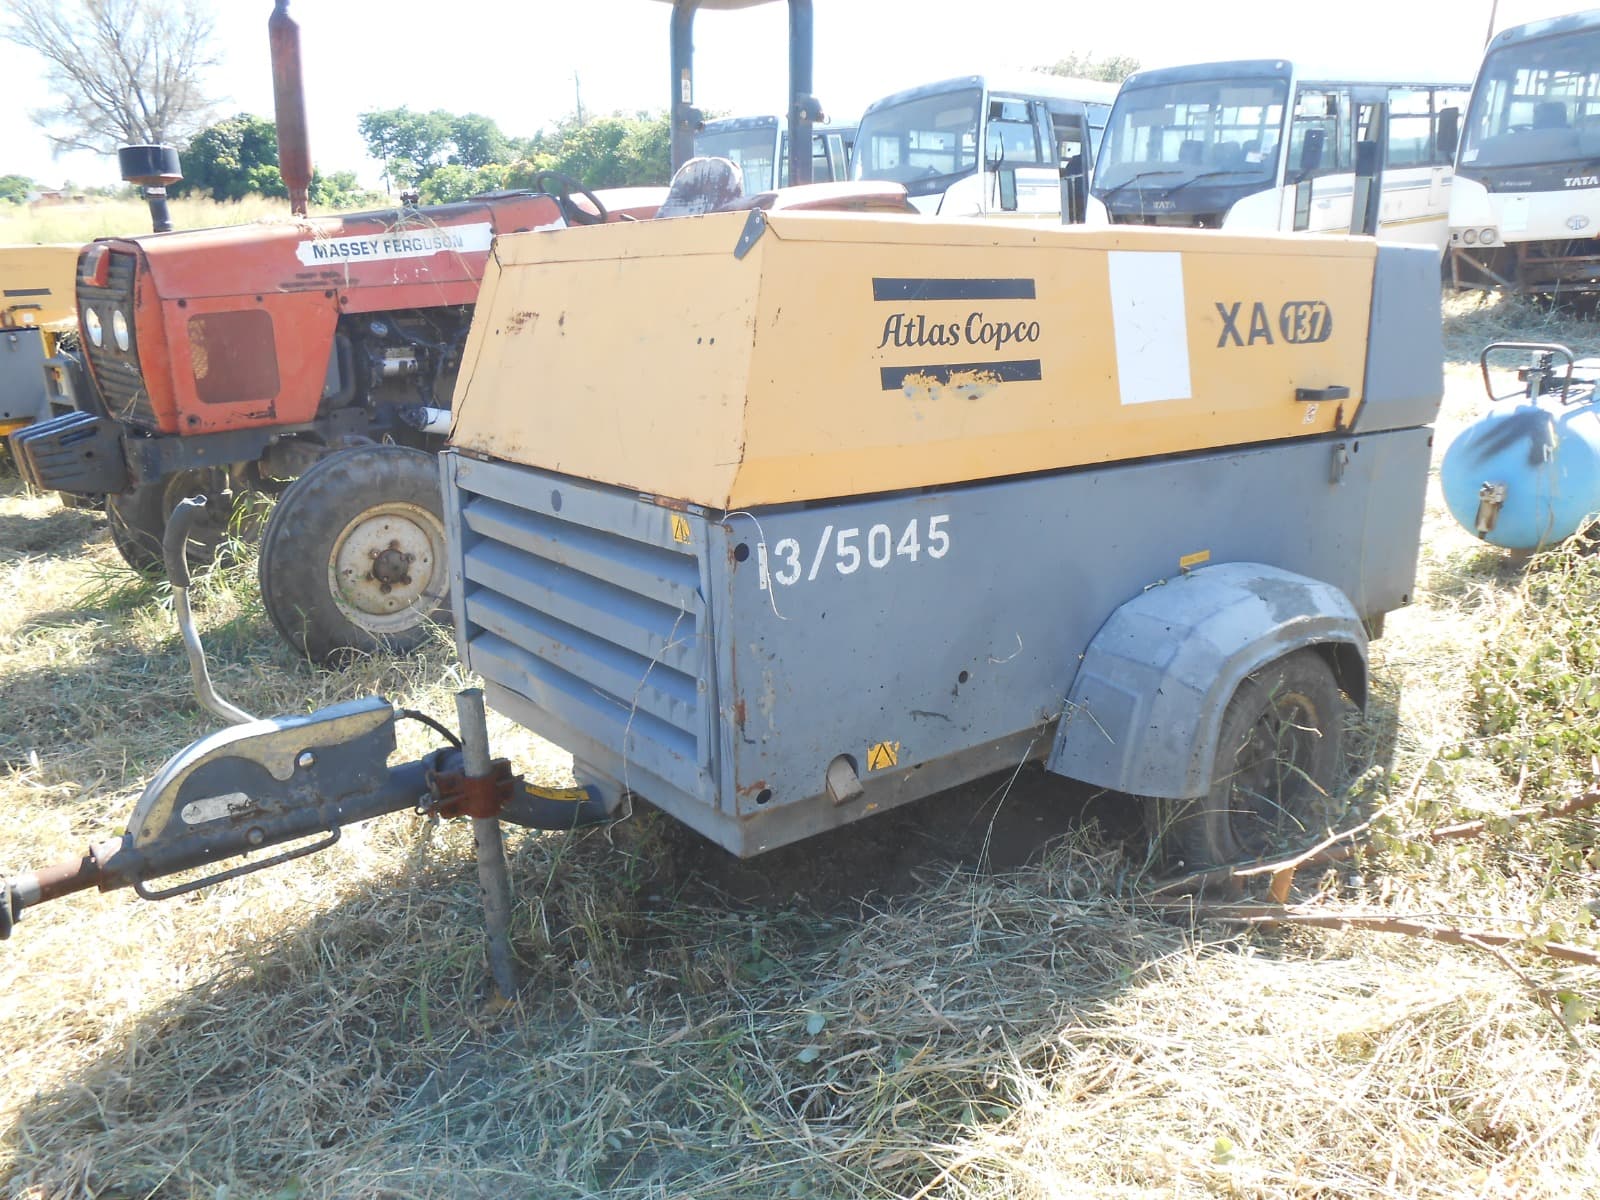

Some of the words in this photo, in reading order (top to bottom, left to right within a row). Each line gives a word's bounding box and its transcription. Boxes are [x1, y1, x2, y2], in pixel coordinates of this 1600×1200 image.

[1563, 175, 1599, 187] TATA
[312, 239, 379, 259] MASSEY
[383, 235, 464, 254] FERGUSON
[877, 313, 961, 349] Atlas
[964, 312, 1040, 351] Copco
[1214, 301, 1275, 348] XA
[1283, 303, 1328, 342] 137
[757, 514, 950, 590] 13/5045
